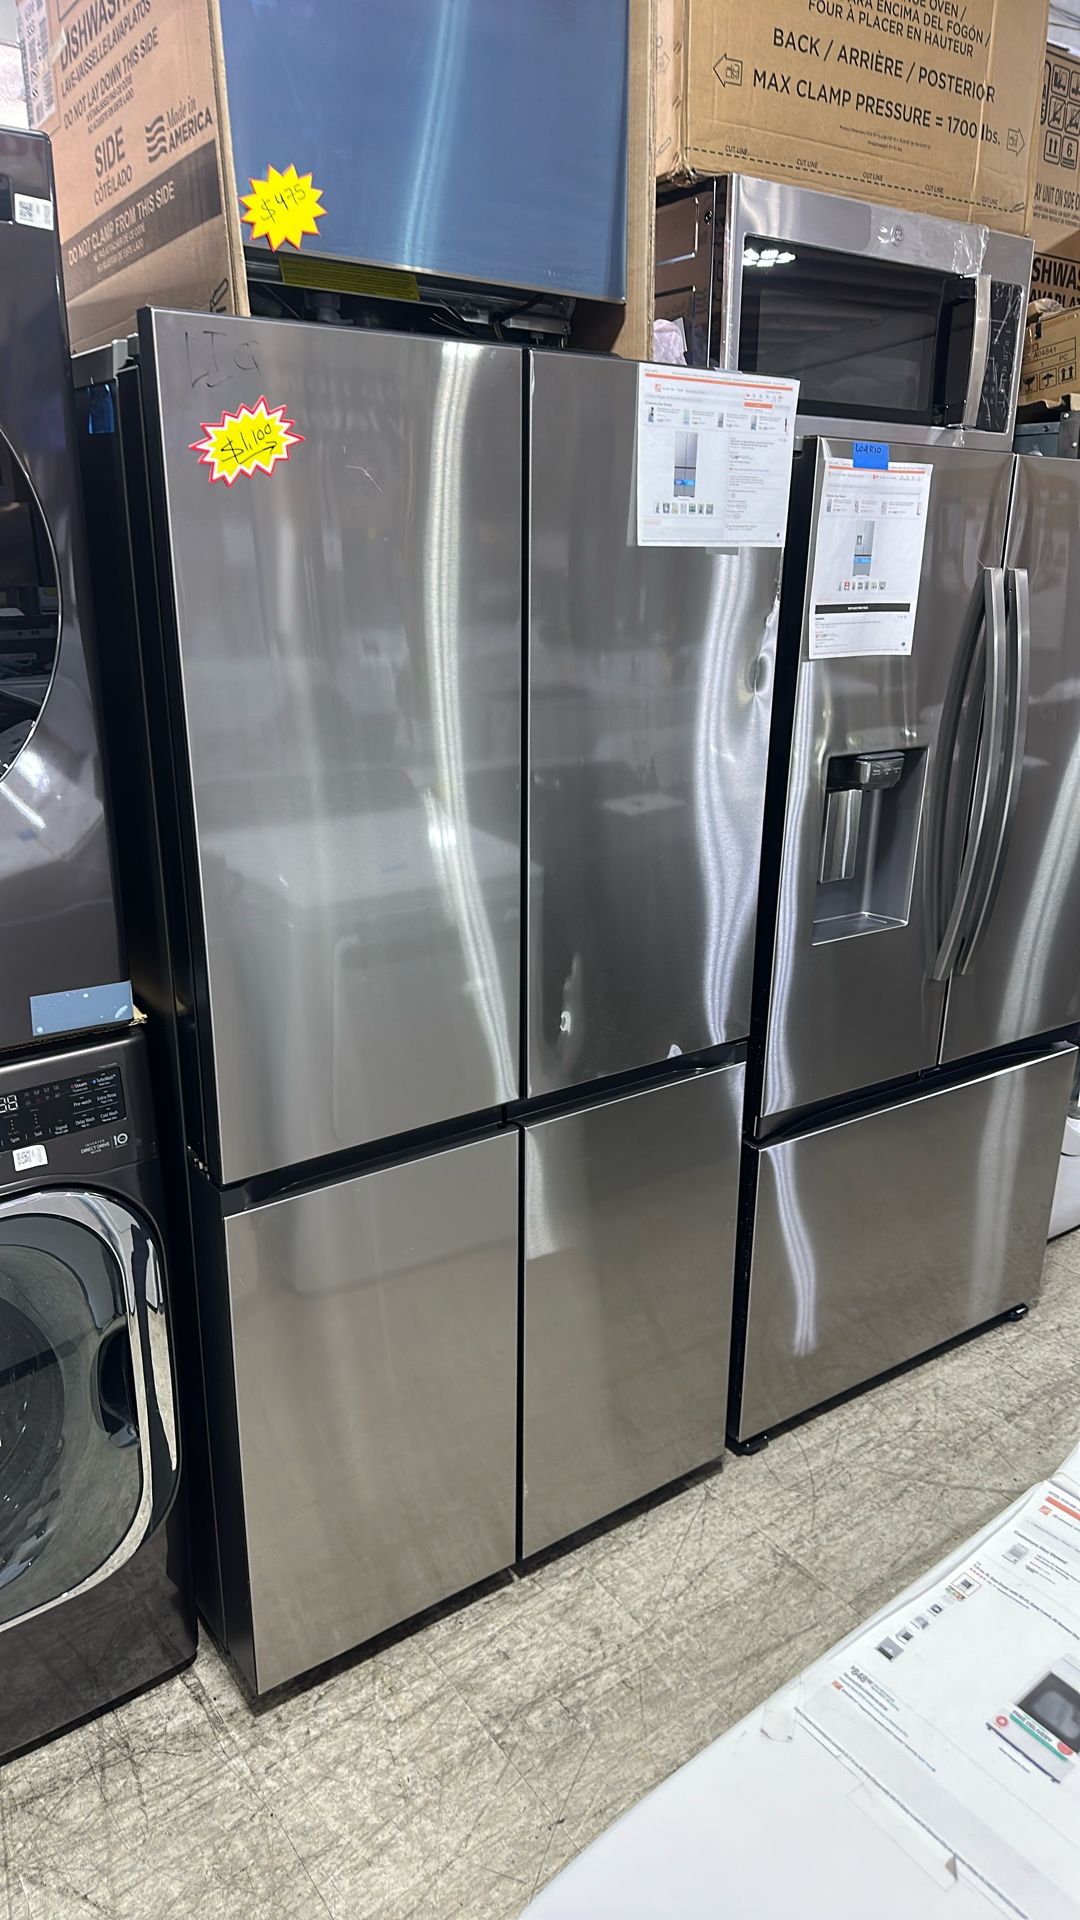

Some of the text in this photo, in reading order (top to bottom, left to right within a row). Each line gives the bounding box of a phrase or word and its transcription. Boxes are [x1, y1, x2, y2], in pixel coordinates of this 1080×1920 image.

[808, 0, 843, 20] FOUR
[858, 11, 904, 37] PLACER
[906, 26, 922, 42] EN
[924, 31, 974, 58] HAUTEUR
[876, 0, 920, 24] ENCIMA
[924, 12, 944, 32] DEL
[946, 20, 984, 44] FOGÓN
[929, 0, 959, 18] OVEN
[100, 61, 122, 96] DOWN
[122, 45, 139, 74] THIS
[140, 26, 160, 59] SIDE
[773, 27, 821, 57] BACK
[836, 44, 904, 79] ARRIÈRE
[918, 66, 996, 104] POSTERIOR
[168, 107, 213, 152] AMERICA
[752, 68, 792, 96] MAX
[796, 80, 852, 108] CLAMP
[856, 93, 932, 128] PRESSURE
[947, 116, 978, 138] 1700
[980, 124, 1001, 146] lbs.
[94, 126, 126, 178] SIDE
[92, 221, 114, 250] CLAMP
[115, 206, 136, 234] FROM
[136, 194, 155, 220] THIS
[155, 180, 176, 208] SIDE
[260, 182, 307, 224] $475
[1031, 257, 1080, 291] SHWA
